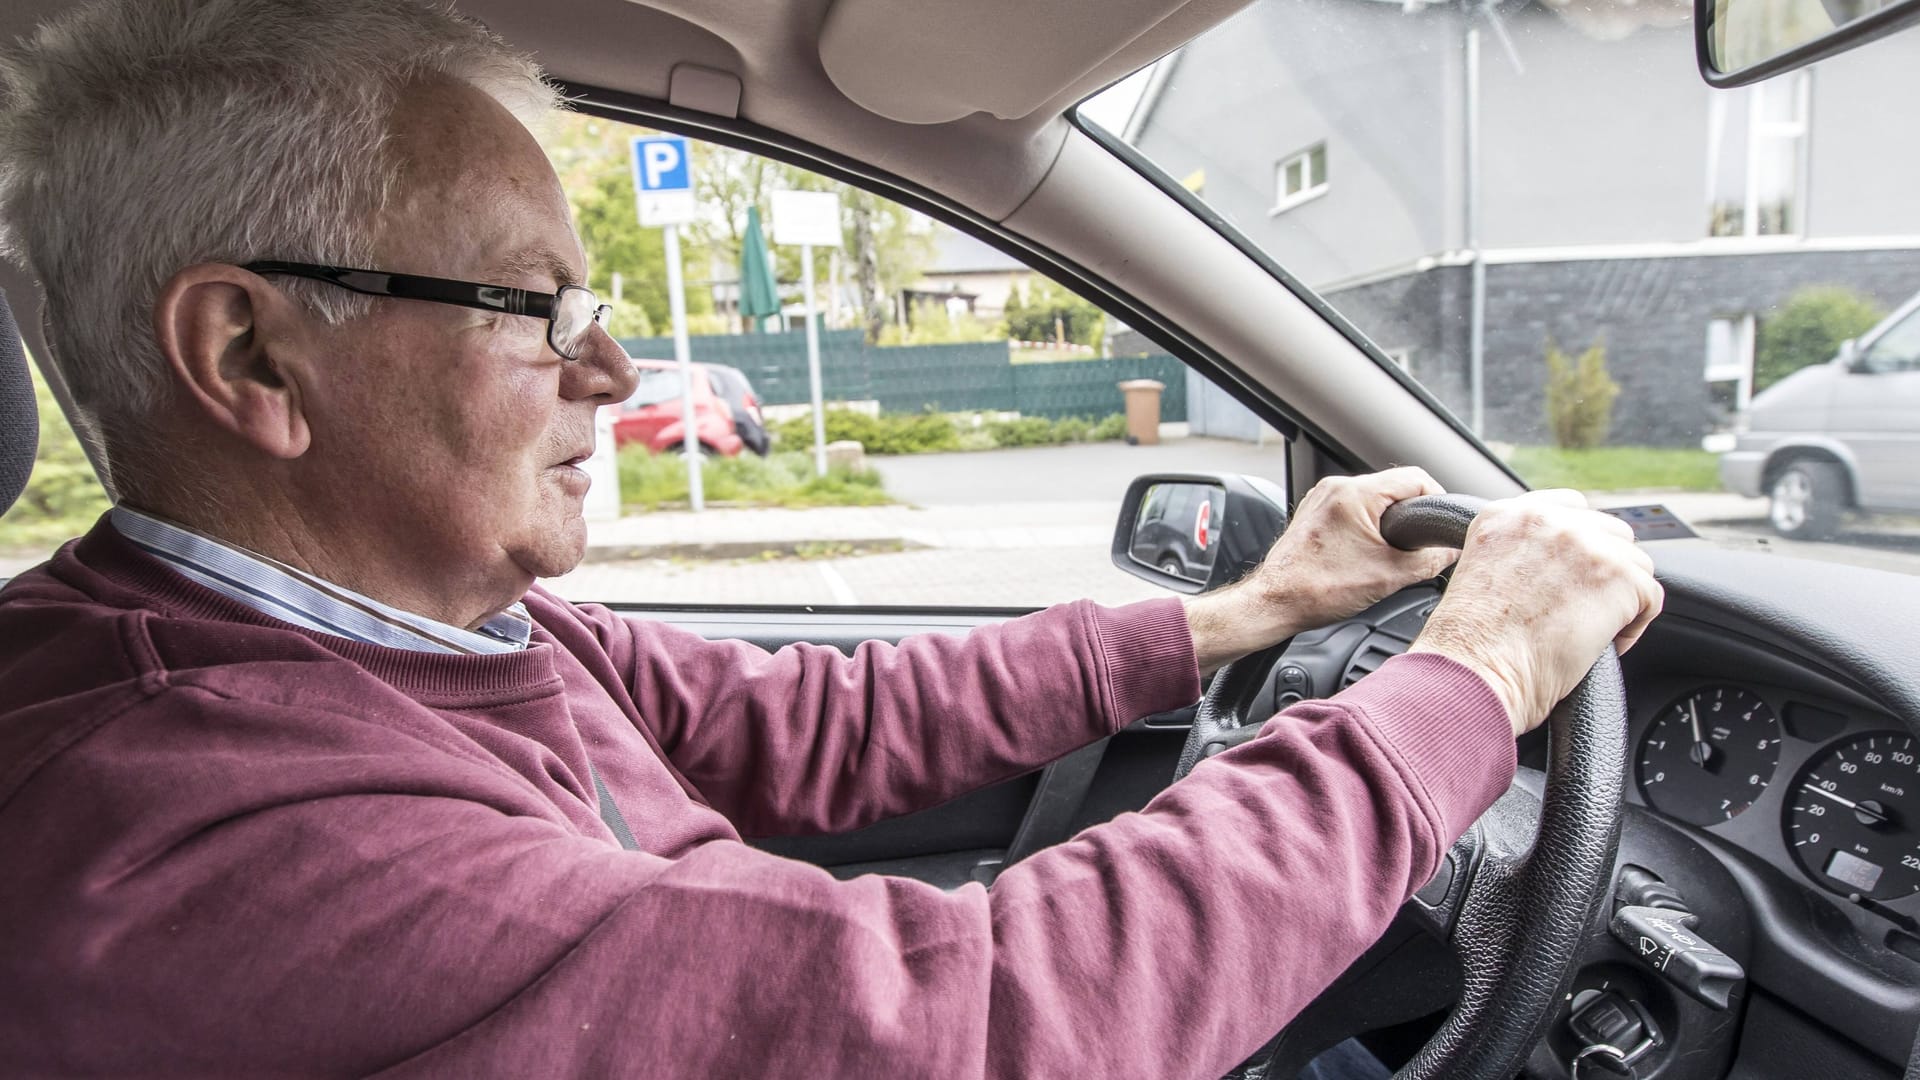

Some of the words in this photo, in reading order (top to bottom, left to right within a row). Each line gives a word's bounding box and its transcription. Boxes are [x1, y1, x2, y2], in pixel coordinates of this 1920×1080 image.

[644, 142, 679, 188] P
[1712, 702, 1722, 712] 3
[1681, 713, 1690, 723] 2
[1742, 712, 1752, 721] 4
[1659, 741, 1666, 750] 1
[1757, 740, 1767, 750] 5
[1864, 752, 1883, 765] 80
[1892, 752, 1914, 766] 100
[1840, 762, 1858, 775] 60
[1655, 772, 1665, 782] 0
[1749, 774, 1760, 785] 6
[1819, 780, 1837, 793] 40
[1880, 782, 1904, 797] km/h
[1720, 799, 1731, 810] 7
[1808, 804, 1826, 817] 20
[1810, 833, 1820, 844] 0
[1854, 843, 1869, 854] km
[1901, 854, 1920, 871] 22
